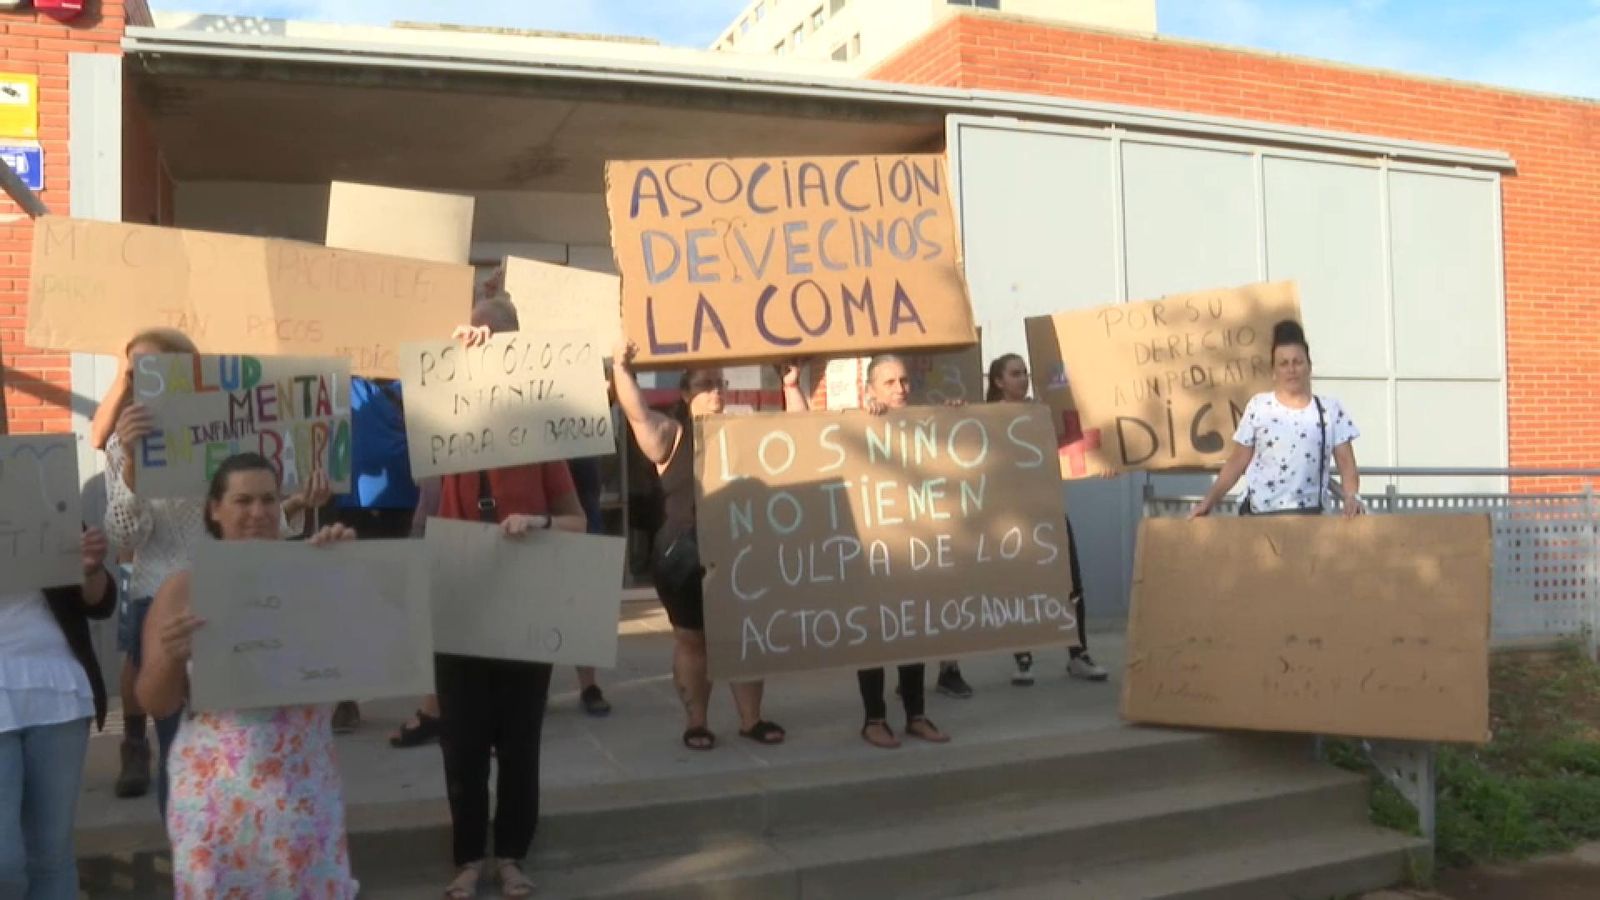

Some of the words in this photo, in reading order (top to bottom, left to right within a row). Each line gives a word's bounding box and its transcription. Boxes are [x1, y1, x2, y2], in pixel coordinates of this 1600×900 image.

[630, 156, 940, 219] ASOCIACIÓN
[641, 229, 721, 285] DE
[733, 209, 943, 281] VECINOS
[646, 292, 732, 356] LA
[755, 277, 926, 347] COMA
[1097, 302, 1168, 337] POR
[1184, 298, 1222, 322] SU
[1134, 325, 1256, 366] DERECHO
[139, 354, 262, 398] SALUD
[229, 372, 348, 433] MENTAL
[1166, 356, 1268, 396] PEDIATR
[141, 425, 194, 469] EN
[190, 414, 258, 446] INFANTIL
[430, 428, 494, 466] PARA
[719, 423, 846, 482] LOS
[865, 415, 1044, 470] NIÑOS
[729, 491, 801, 539] NO
[821, 473, 986, 530] TIENEN
[731, 535, 891, 600] CULPA
[909, 533, 955, 572] DE
[977, 522, 1058, 565] LOS
[741, 605, 868, 661] ACTOS
[880, 600, 917, 642] DE
[924, 595, 975, 635] LOS
[980, 593, 1079, 632] ADULTOS
